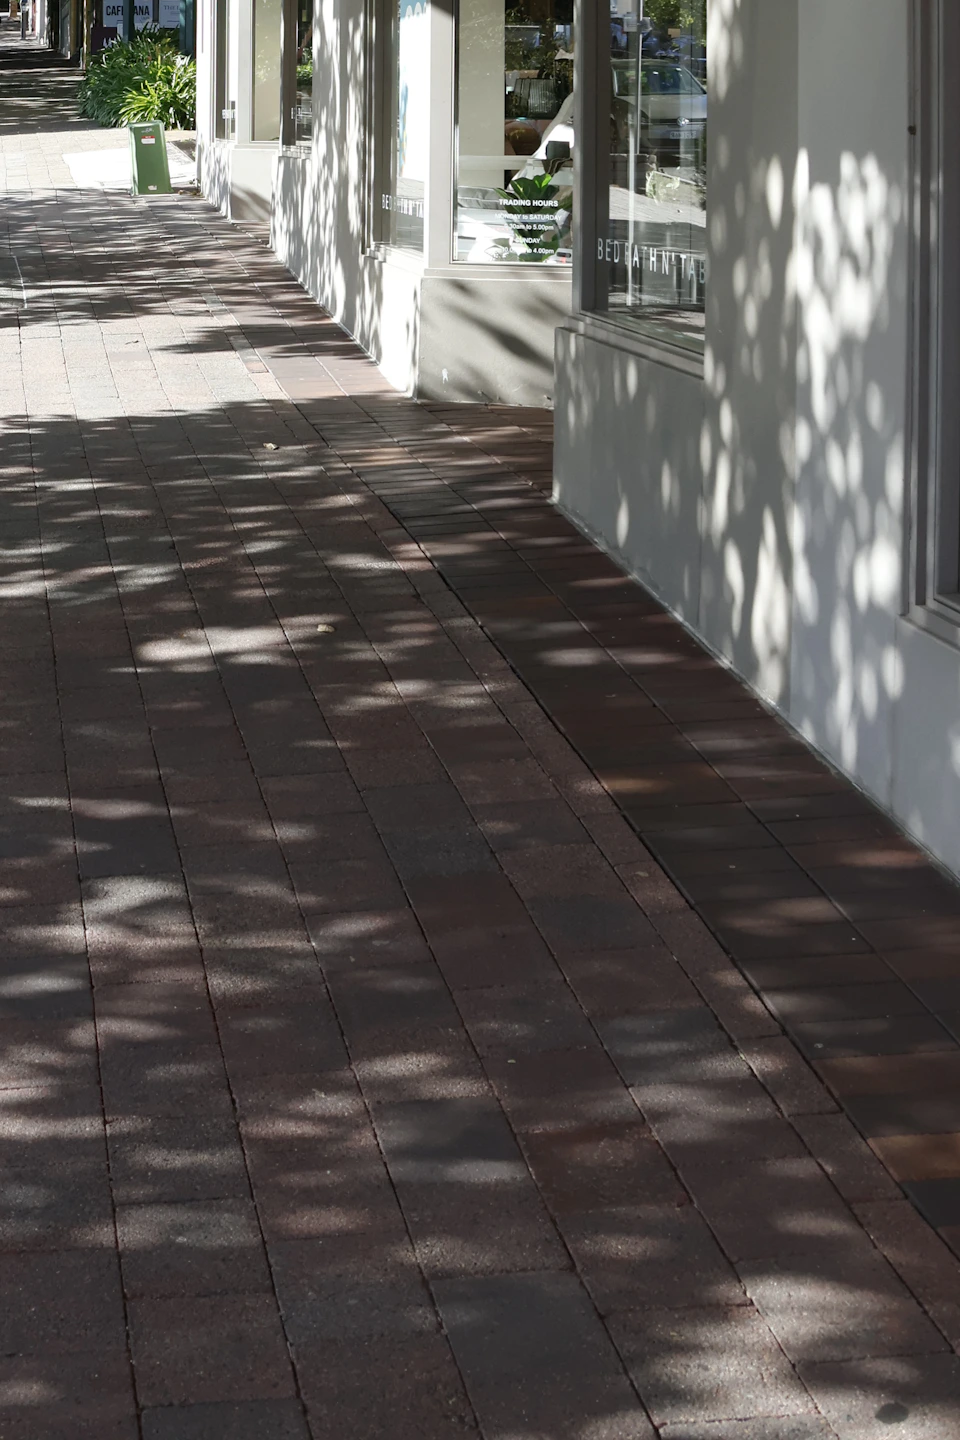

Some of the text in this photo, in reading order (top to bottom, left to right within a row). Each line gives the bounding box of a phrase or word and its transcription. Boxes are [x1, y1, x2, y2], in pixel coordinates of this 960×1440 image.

[499, 199, 531, 207] TRADING
[533, 224, 554, 232] 5.00pm
[597, 238, 620, 263] BED
[624, 241, 657, 272] BATH
